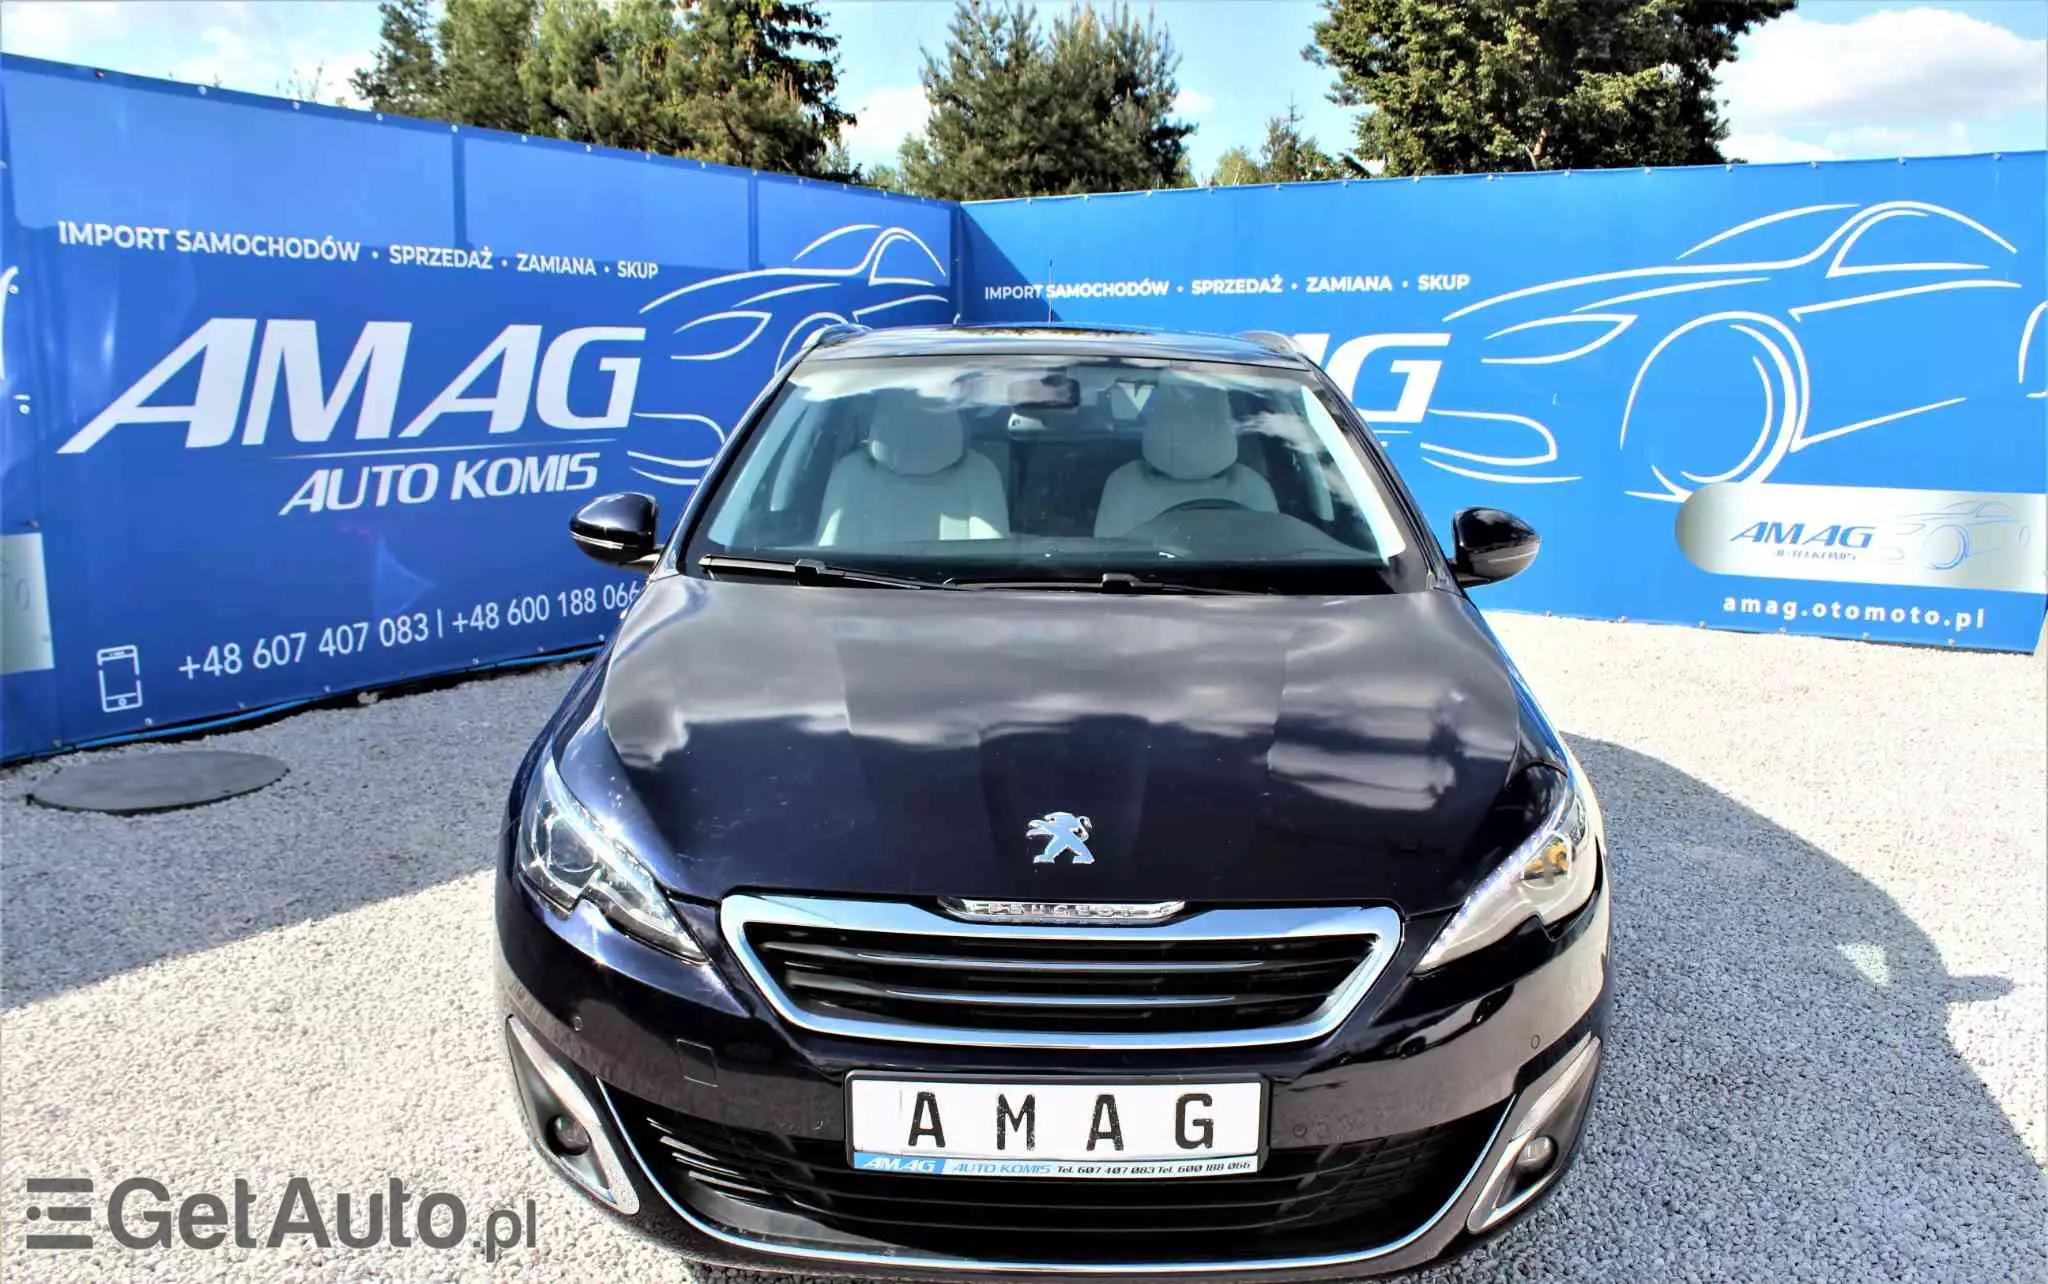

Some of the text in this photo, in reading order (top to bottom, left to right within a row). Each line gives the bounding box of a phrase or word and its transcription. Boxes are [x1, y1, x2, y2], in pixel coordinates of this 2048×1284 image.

[57, 220, 659, 280] IMPORT SAMOCHODÓW SPRZEDAŻ ZAMIANA SKUP
[984, 273, 1471, 300] IMPORT SAMOCHODÓW SPRZEDAŻ ZAMIANA SKUP
[279, 452, 601, 516] AUTO KOMIS
[178, 642, 243, 680] +48
[252, 632, 307, 669] 607
[318, 622, 370, 657] 407
[378, 611, 430, 648] 083
[452, 602, 500, 633] +48
[507, 595, 550, 626] 600
[558, 587, 597, 617] 188
[1723, 596, 1986, 632] amag.otomoto.pl
[952, 1162, 997, 1174] AUTO
[999, 1163, 1051, 1175] KOMIS
[1077, 1166, 1101, 1174] 607
[1104, 1166, 1128, 1175] 407
[1130, 1166, 1156, 1175] 083
[1177, 1164, 1203, 1173] 600
[1206, 1162, 1225, 1172] 188
[1227, 1160, 1251, 1170] 066
